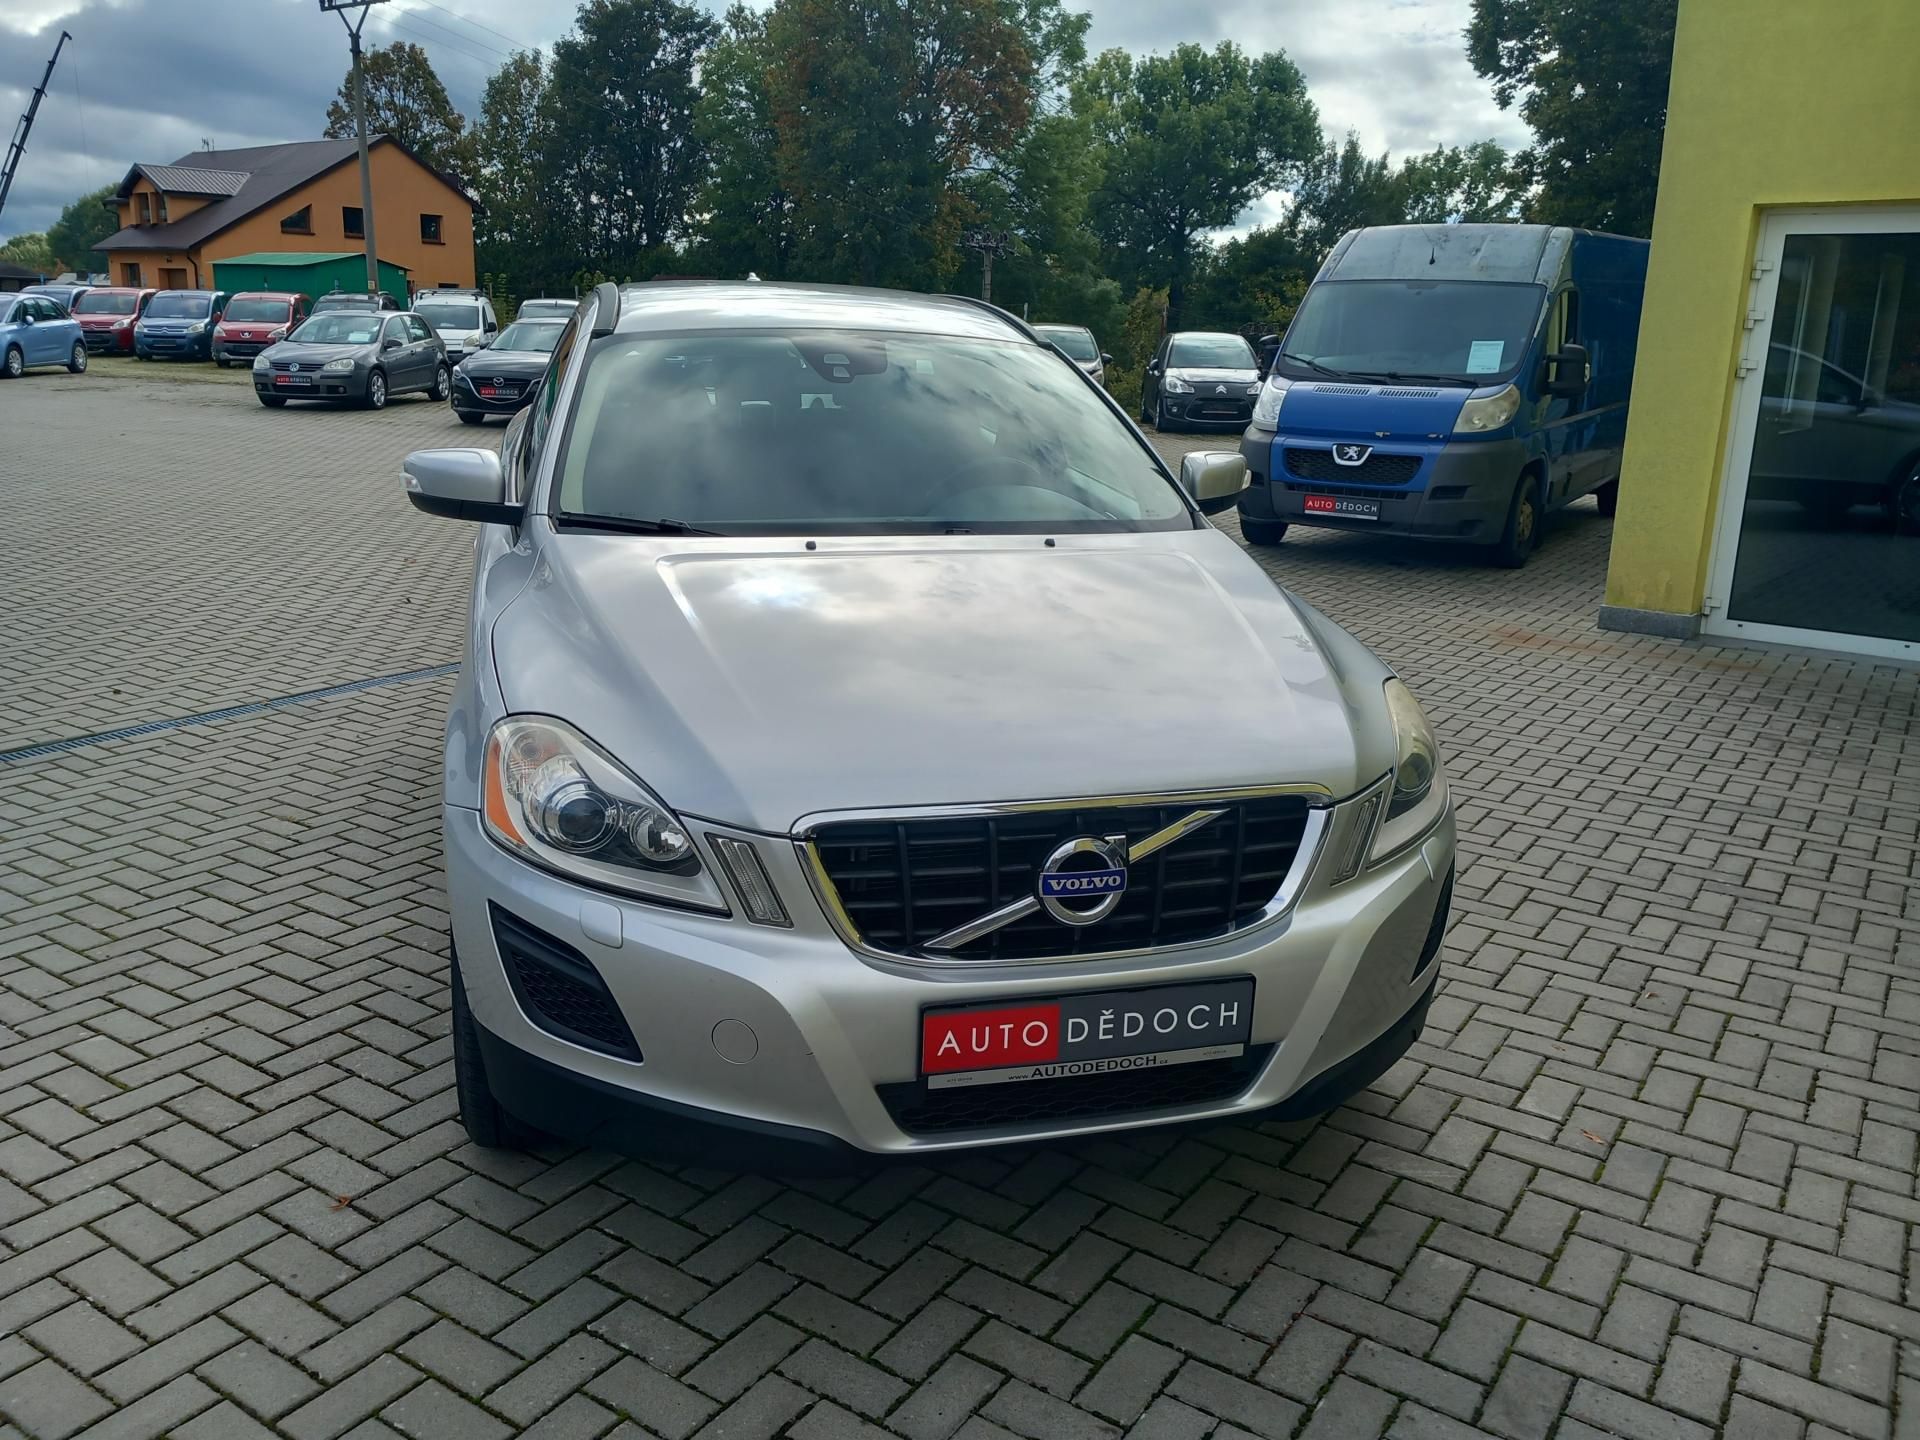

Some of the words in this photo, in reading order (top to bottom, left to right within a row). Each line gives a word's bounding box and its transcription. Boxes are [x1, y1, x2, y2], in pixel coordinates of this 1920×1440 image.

[1307, 500, 1333, 509] AUTO
[1048, 875, 1121, 891] VOLVO
[937, 1020, 1049, 1056] AUTO
[1067, 1001, 1239, 1043] DĚDOCH
